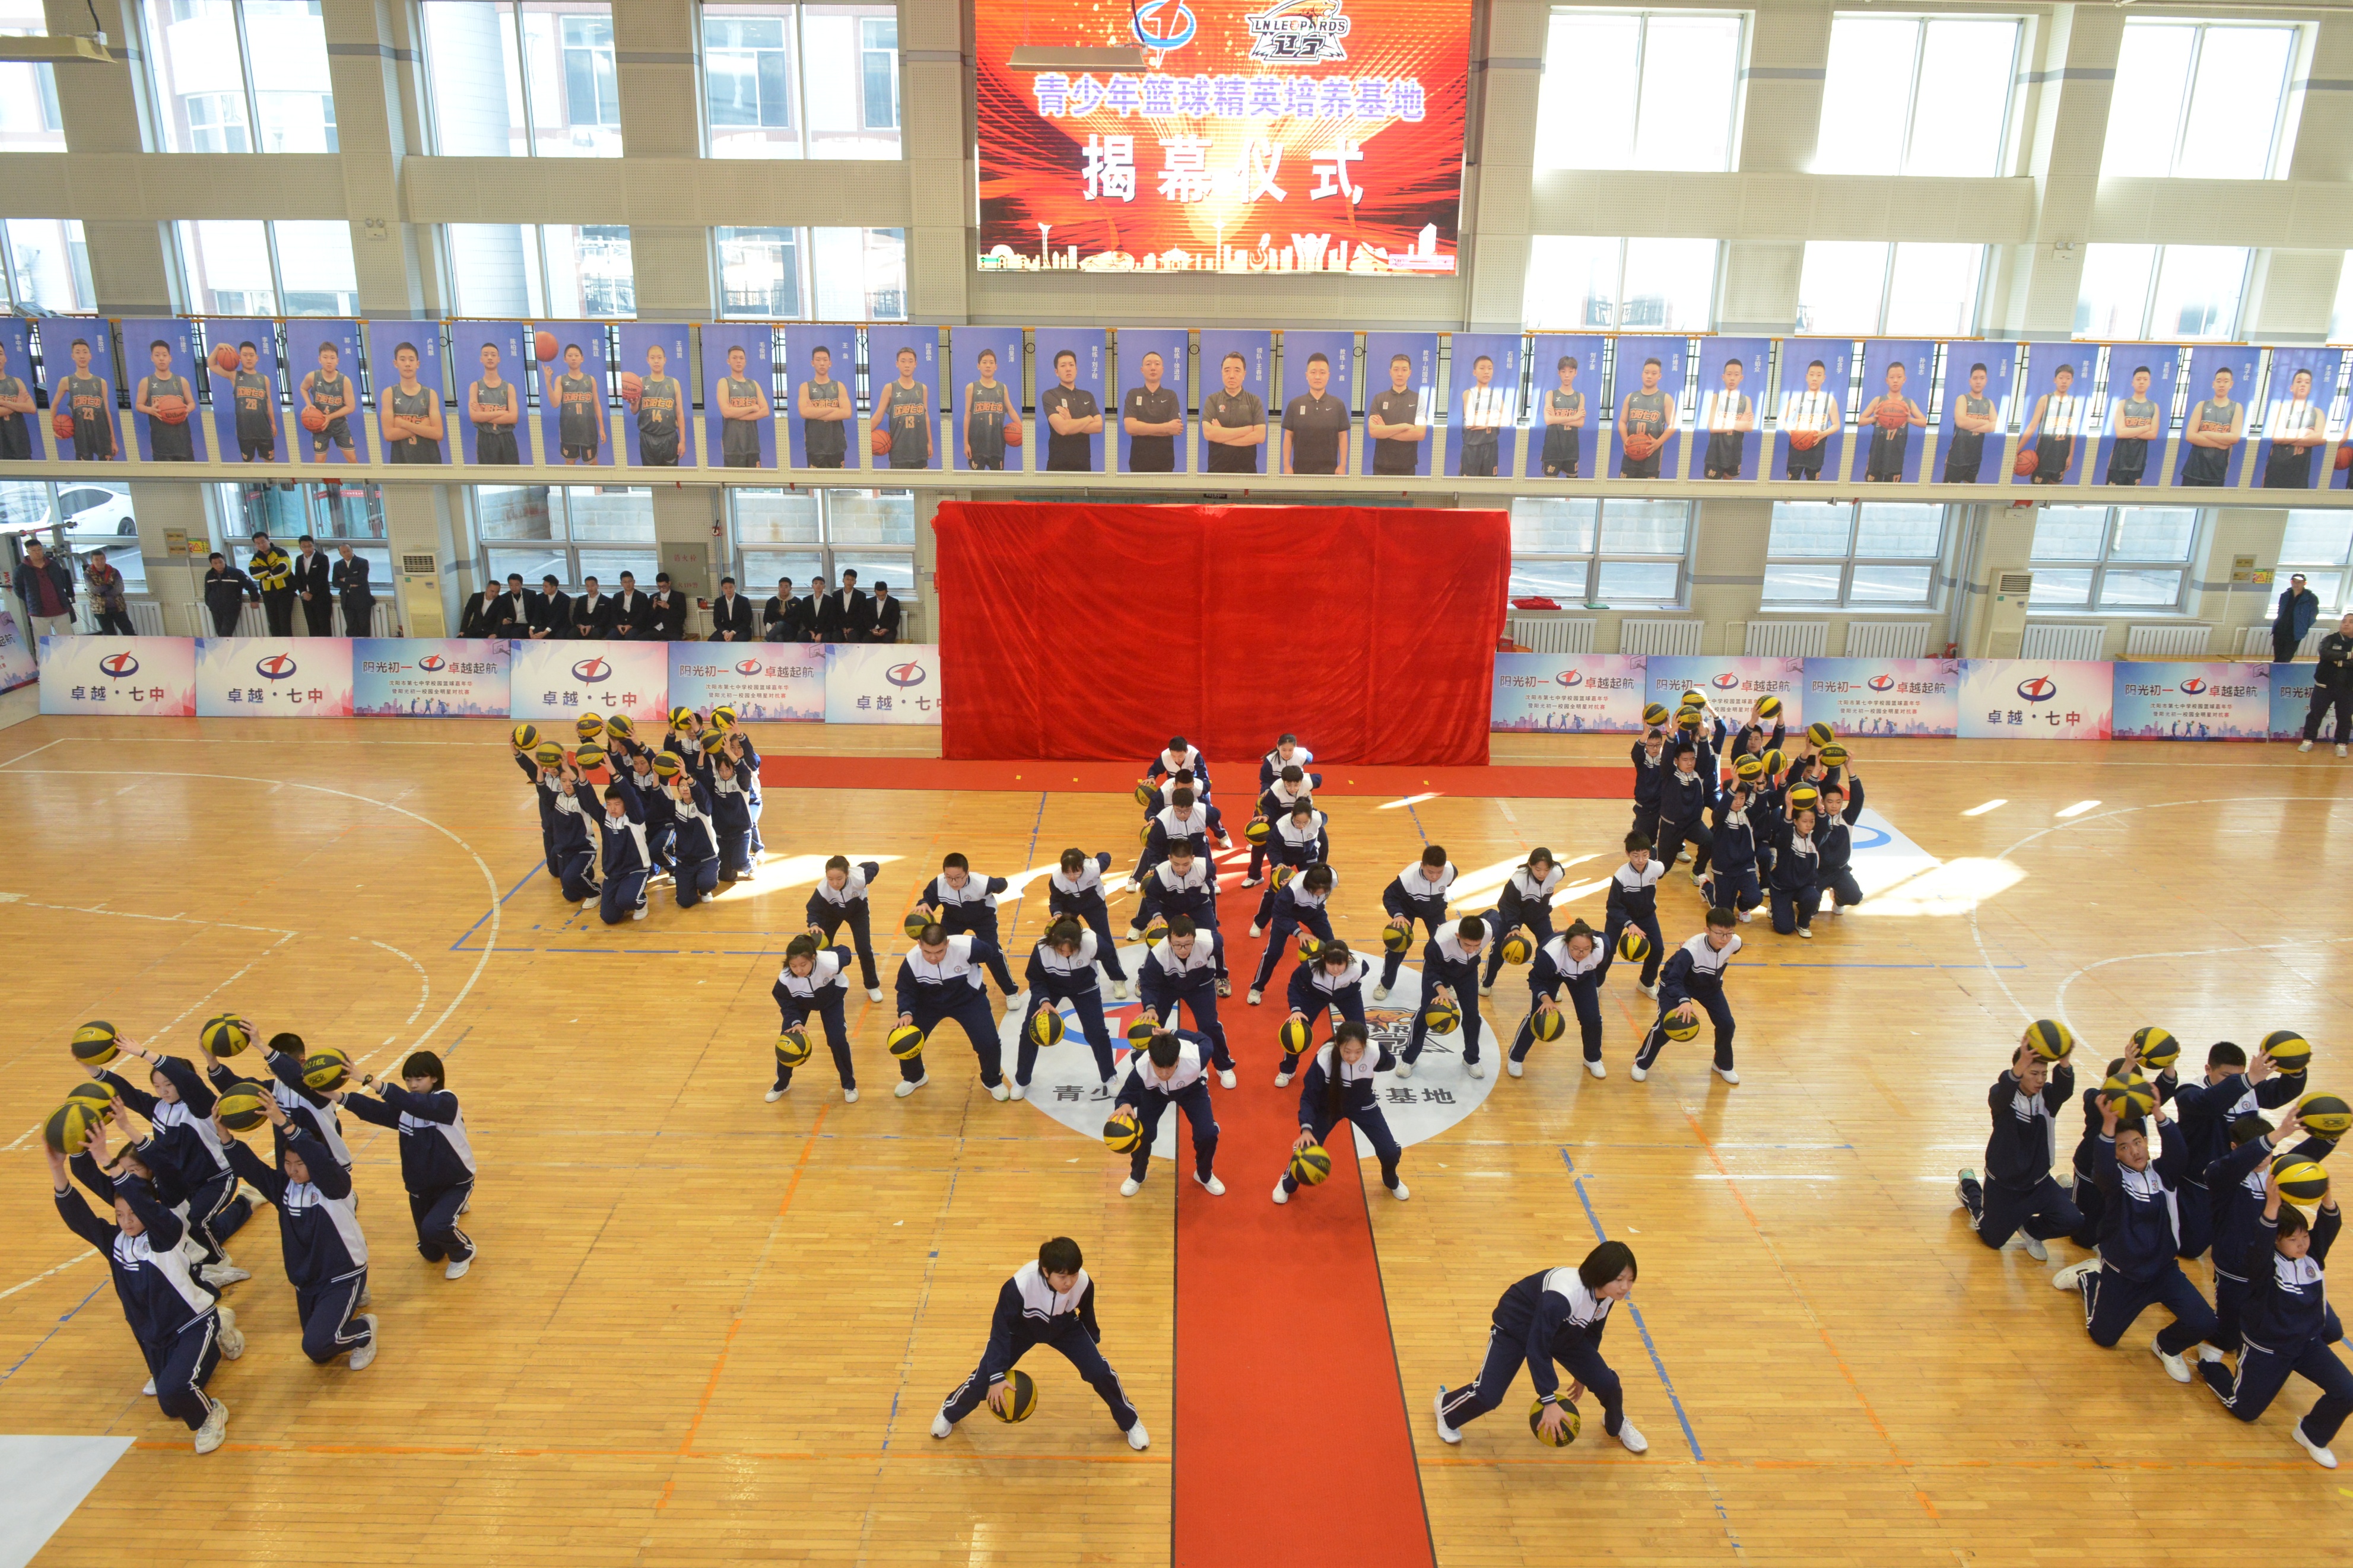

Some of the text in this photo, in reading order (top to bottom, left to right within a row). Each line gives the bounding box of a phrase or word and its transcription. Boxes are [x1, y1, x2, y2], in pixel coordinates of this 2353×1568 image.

[1034, 75, 1424, 120] 青少年篮球精英培养基地
[1082, 134, 1364, 205] 揭幕仪式
[237, 387, 265, 399] 沈阳七中
[564, 392, 592, 403] 沈阳七中
[246, 399, 257, 410] 28
[576, 403, 582, 414] 11
[642, 397, 674, 411] 沈阳七中
[974, 402, 1003, 414] 沈阳七中
[82, 408, 94, 421] 23
[652, 409, 662, 422] 14
[894, 404, 925, 418] 沈阳七中
[905, 416, 914, 428] 13
[989, 414, 993, 425] 1
[363, 661, 498, 674] 阳光初一 卓越起航
[679, 665, 814, 678] 阳光初一 卓越起航
[1500, 675, 1635, 689] 阳光初一 卓越起航
[1656, 679, 1790, 692] 阳光初一 卓越起航
[1812, 681, 1946, 694] 阳光初一 卓越起航
[2125, 684, 2258, 698] 阳光初一 卓越起航
[2281, 686, 2314, 698] 阳光初
[1373, 1087, 1456, 1105] 基地
